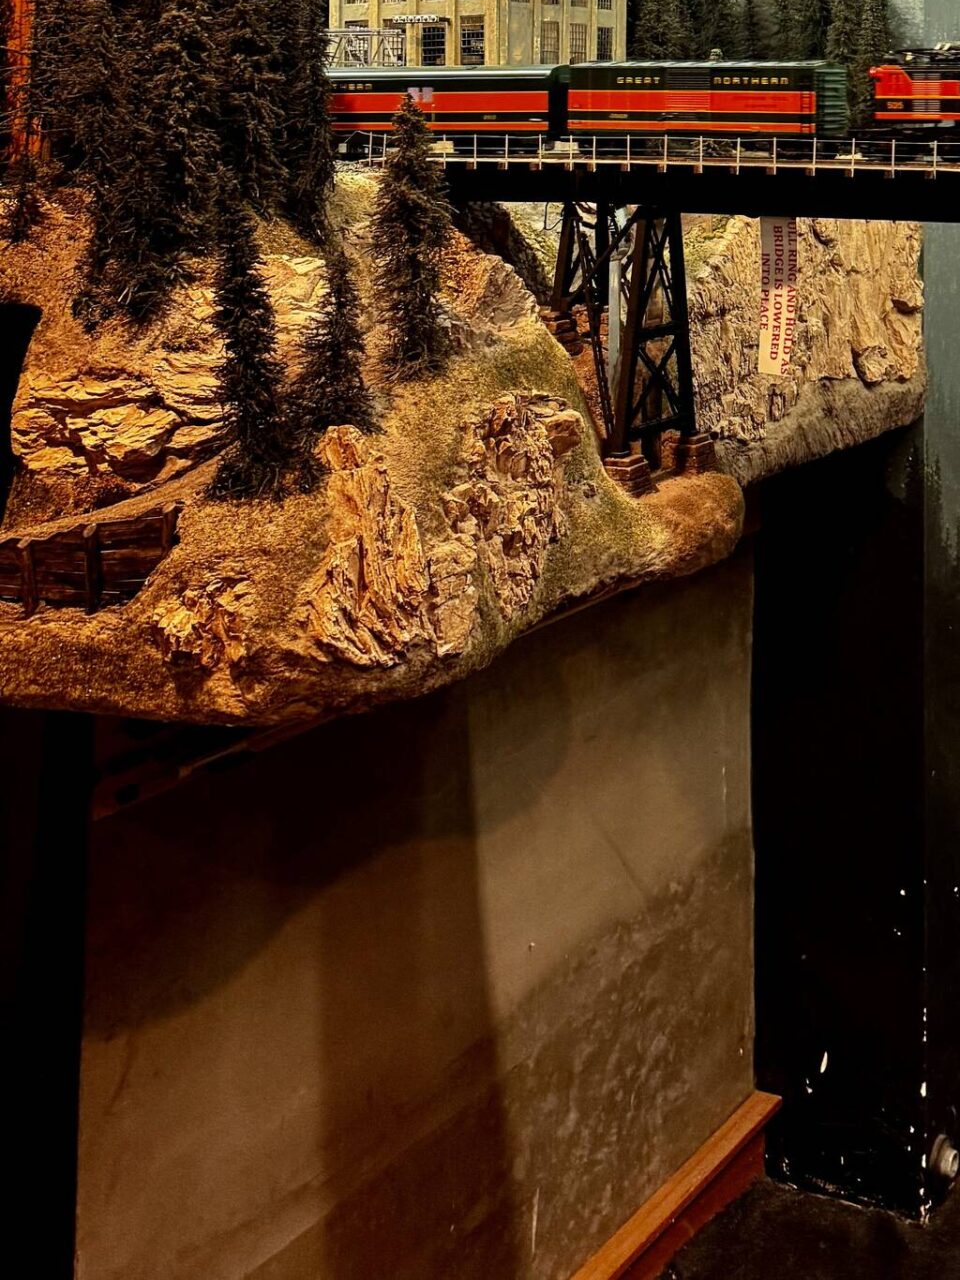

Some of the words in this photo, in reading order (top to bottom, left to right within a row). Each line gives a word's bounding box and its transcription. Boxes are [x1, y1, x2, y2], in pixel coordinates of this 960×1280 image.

[616, 76, 661, 84] GREAT
[713, 76, 789, 85] NORTHERN
[773, 225, 784, 276] BRIDGE
[788, 247, 797, 282] RING
[761, 253, 771, 285] INTO
[774, 278, 783, 291] IS
[760, 289, 770, 331] PLACE
[787, 285, 796, 313] AND
[769, 293, 783, 360] LOWERED
[783, 319, 795, 355] HOLD
[780, 359, 790, 375] AS
